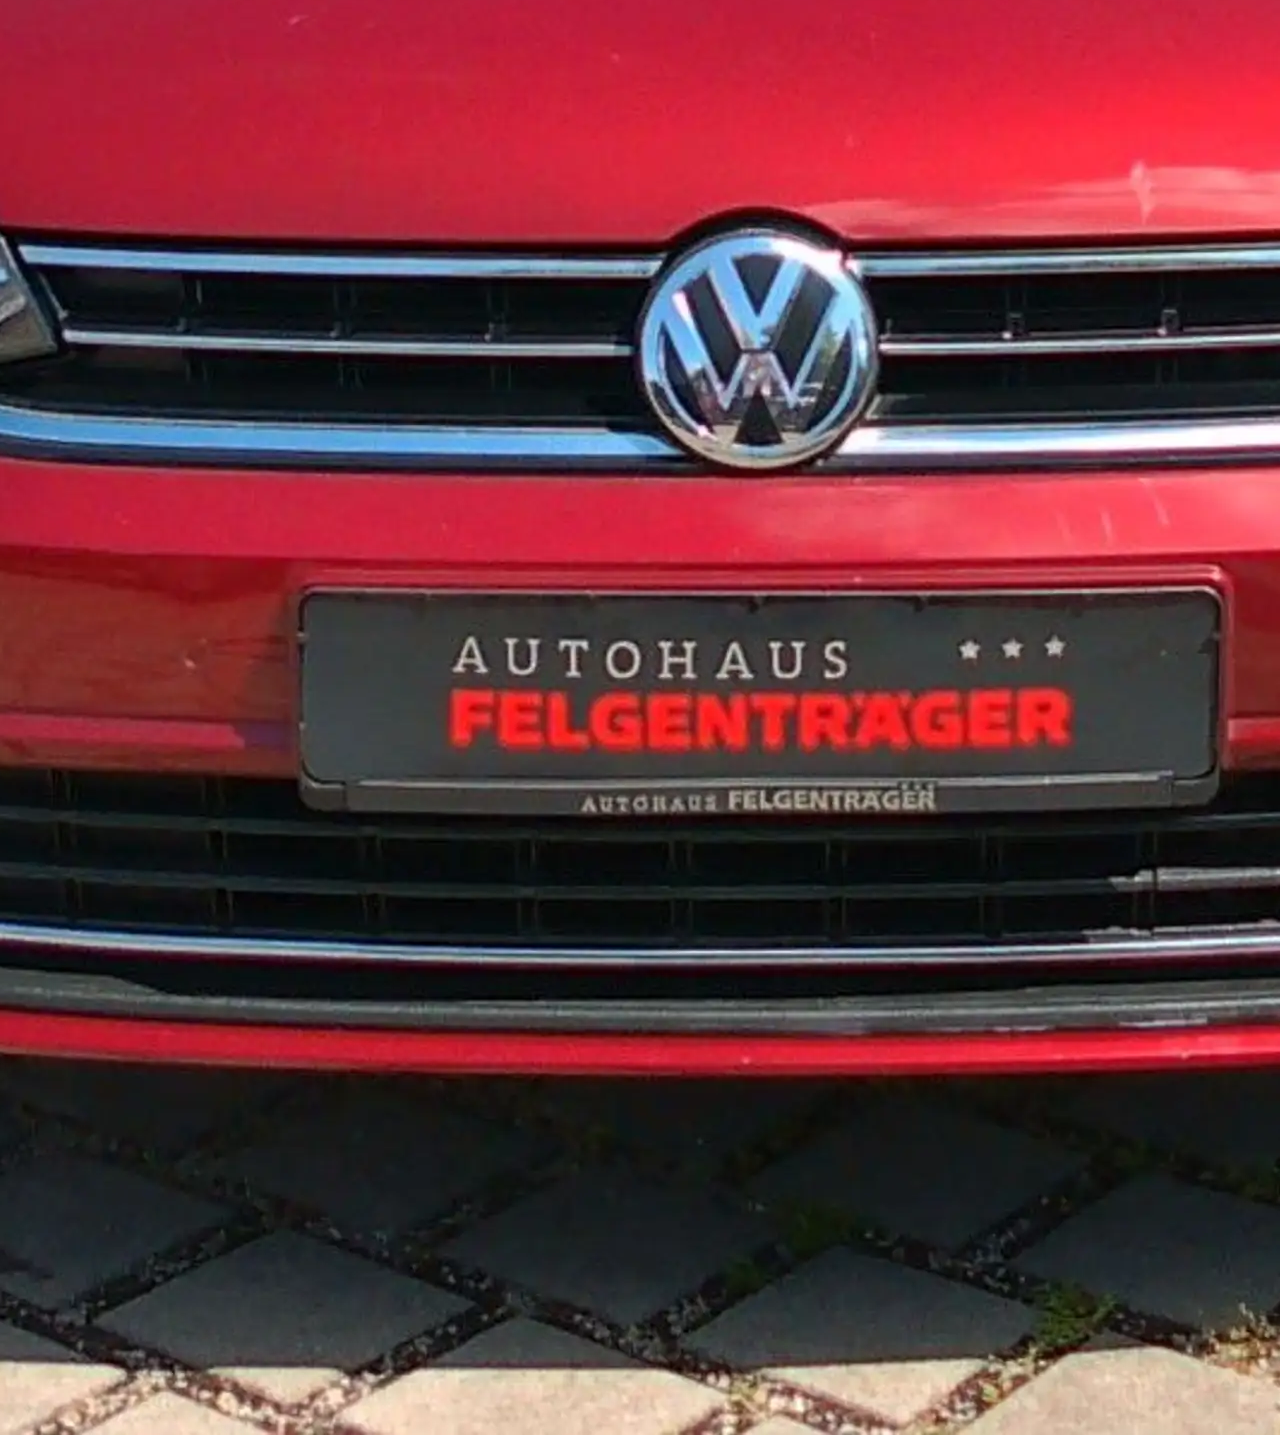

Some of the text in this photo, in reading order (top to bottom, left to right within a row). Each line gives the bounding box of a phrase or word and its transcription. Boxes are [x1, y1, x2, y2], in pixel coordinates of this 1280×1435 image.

[451, 635, 851, 681] AUTOHAUS
[448, 687, 1074, 752] FELGENTRÄGER
[580, 793, 719, 814] AUTOHAUS
